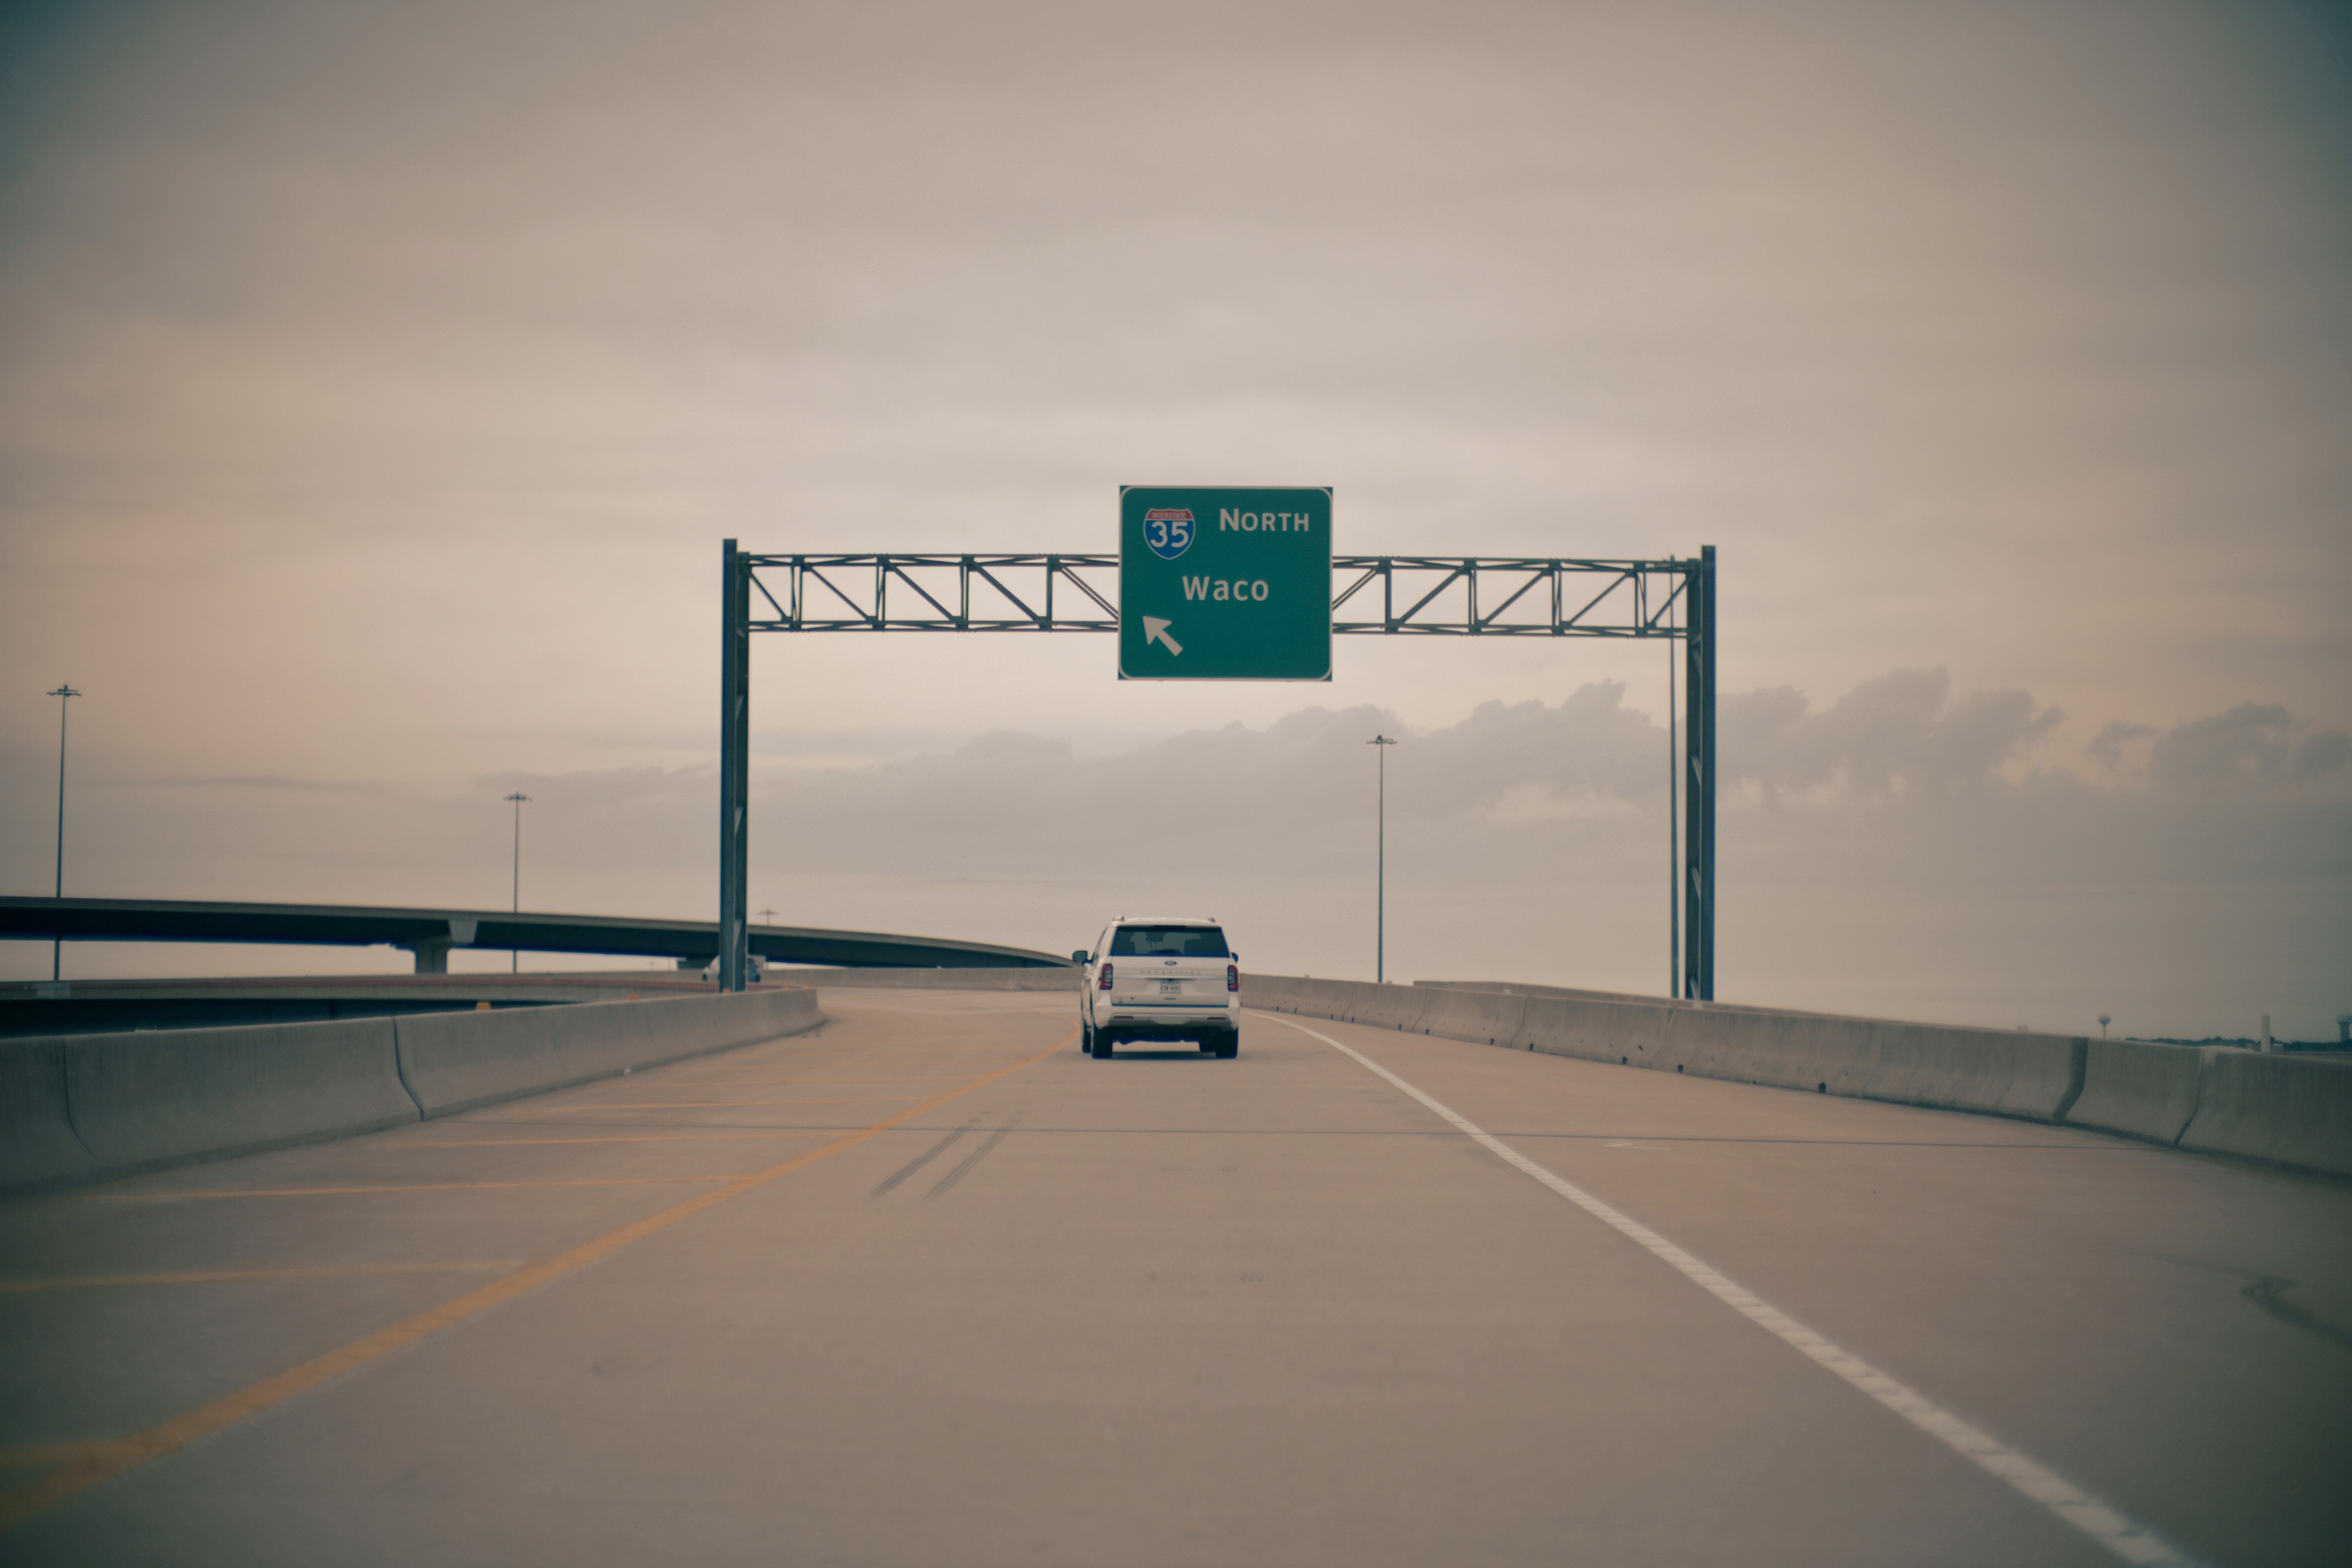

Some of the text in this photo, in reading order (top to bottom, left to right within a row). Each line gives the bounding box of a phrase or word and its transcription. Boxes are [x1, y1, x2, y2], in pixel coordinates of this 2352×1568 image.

[1220, 508, 1309, 531] NORTH
[1150, 521, 1188, 548] 35
[1183, 576, 1269, 601] Waco
